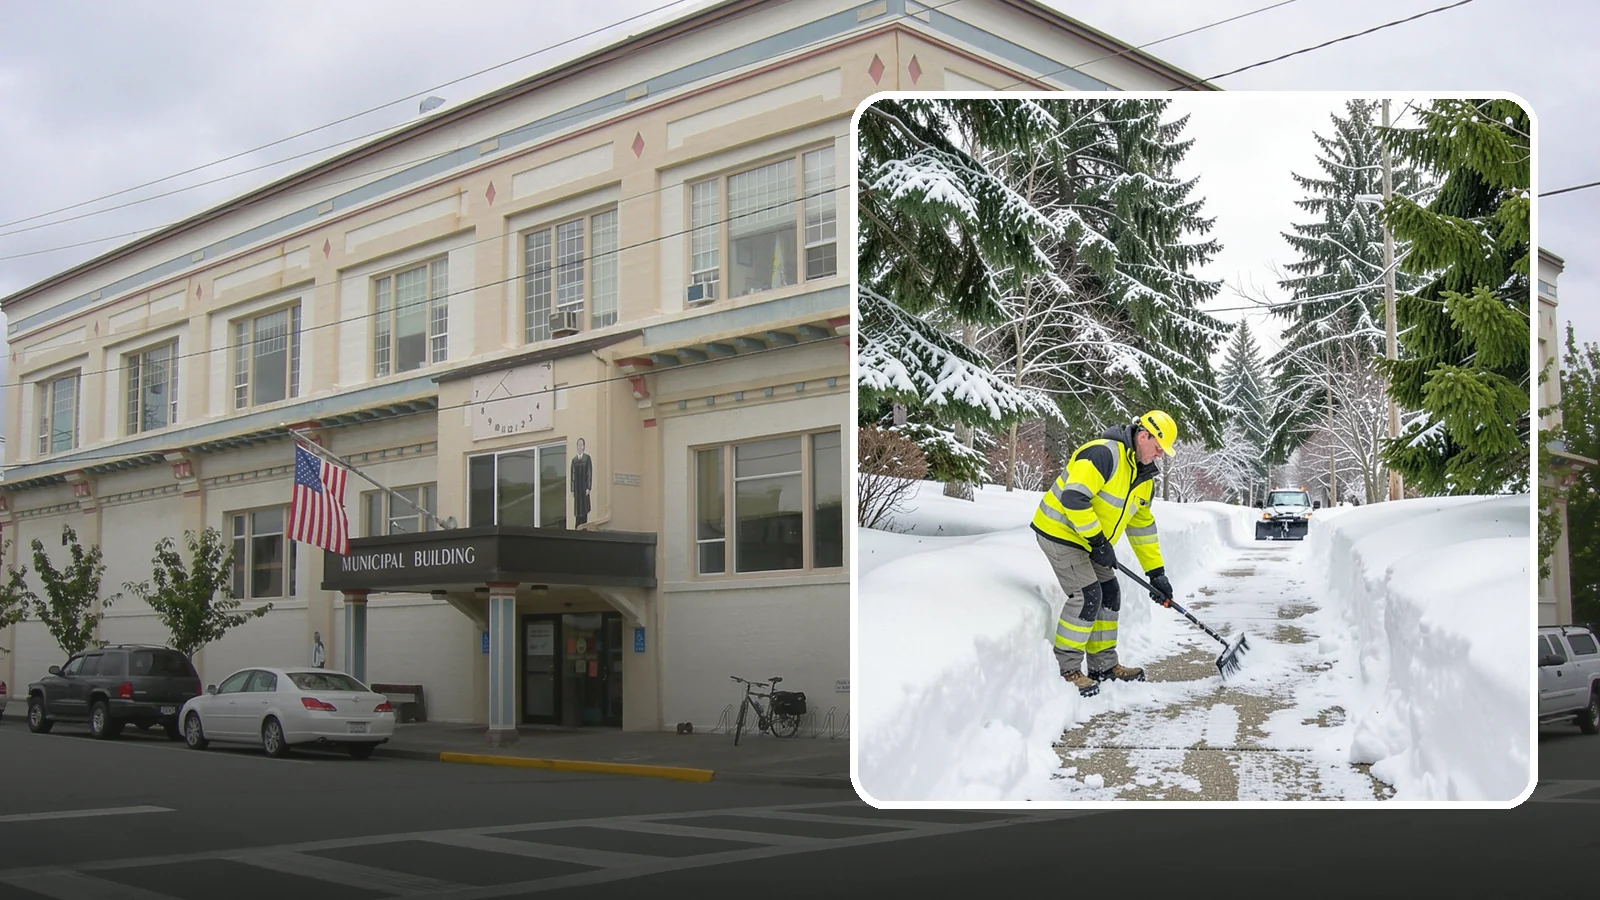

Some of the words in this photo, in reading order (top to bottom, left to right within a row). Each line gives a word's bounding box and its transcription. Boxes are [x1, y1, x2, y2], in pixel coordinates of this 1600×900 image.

[481, 406, 485, 415] 8
[488, 418, 492, 426] 9
[494, 424, 500, 432] 10
[529, 414, 533, 422] 3
[342, 552, 405, 572] MUNICIPAL
[414, 546, 475, 567] BUILDING
